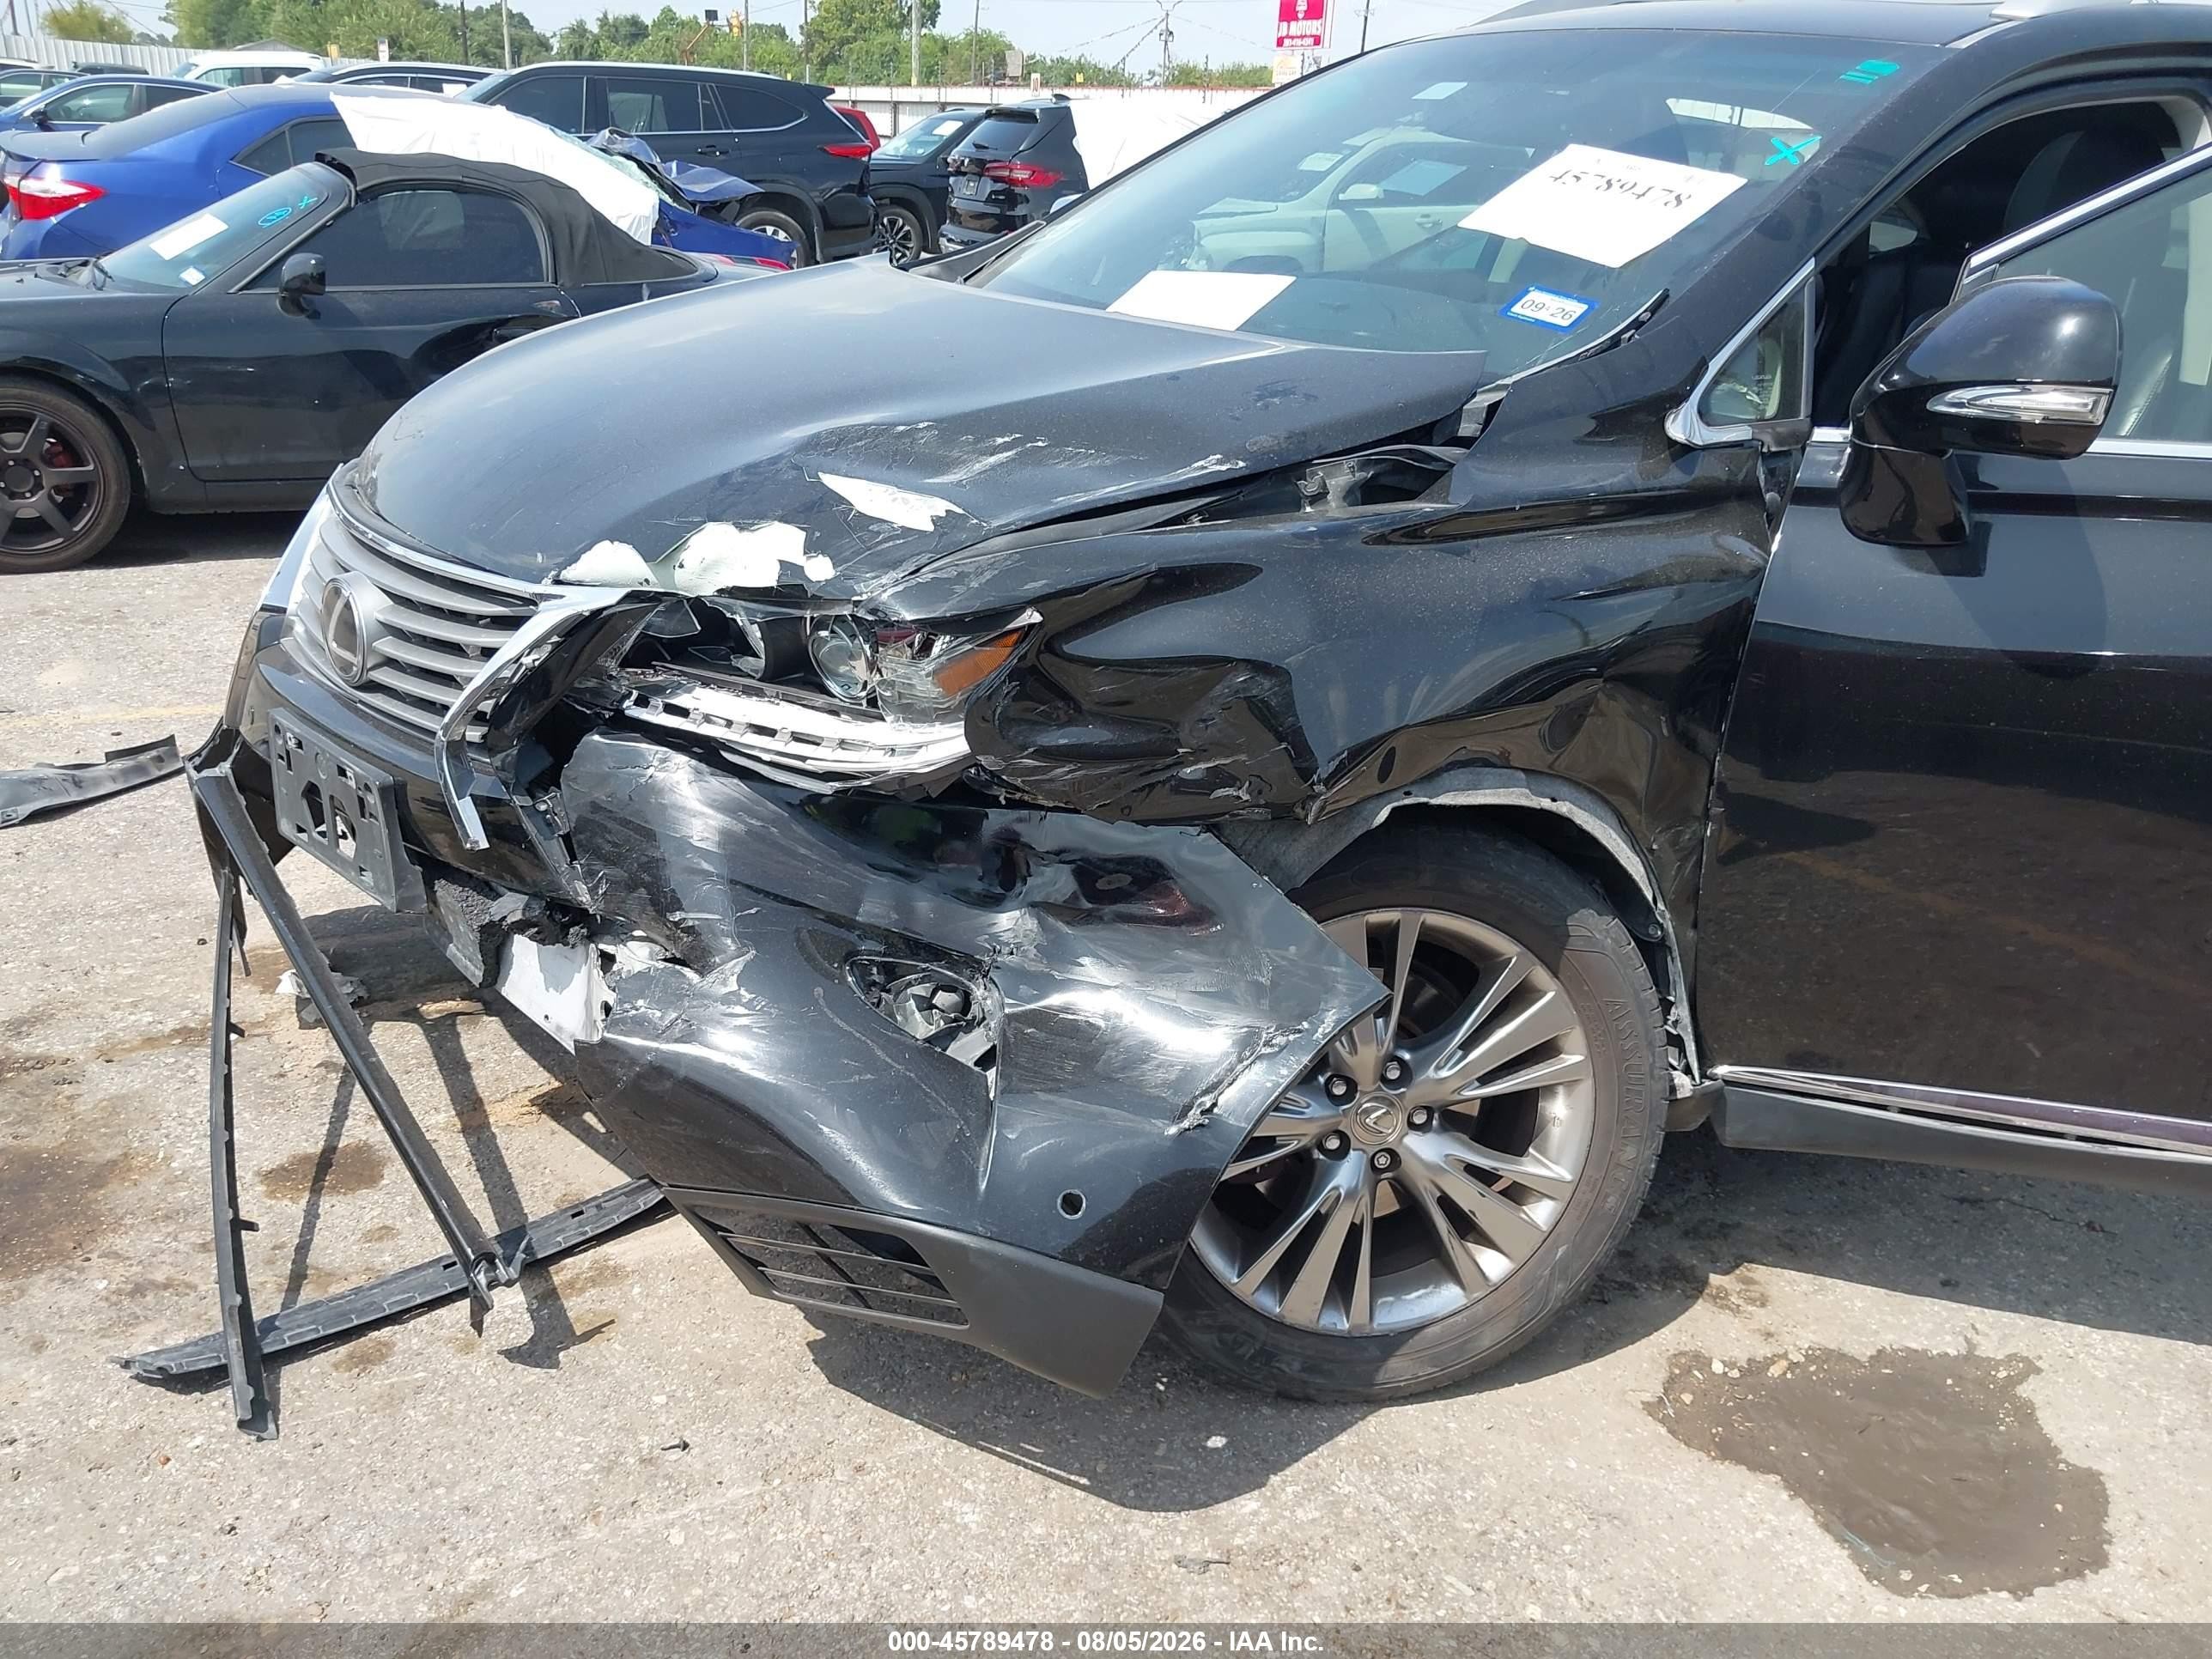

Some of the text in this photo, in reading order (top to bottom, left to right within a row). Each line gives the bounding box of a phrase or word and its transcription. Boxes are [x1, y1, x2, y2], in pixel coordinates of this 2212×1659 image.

[1289, 20, 1322, 36] MOTORS
[1521, 299, 1546, 313] 09
[1550, 307, 1577, 321] 26
